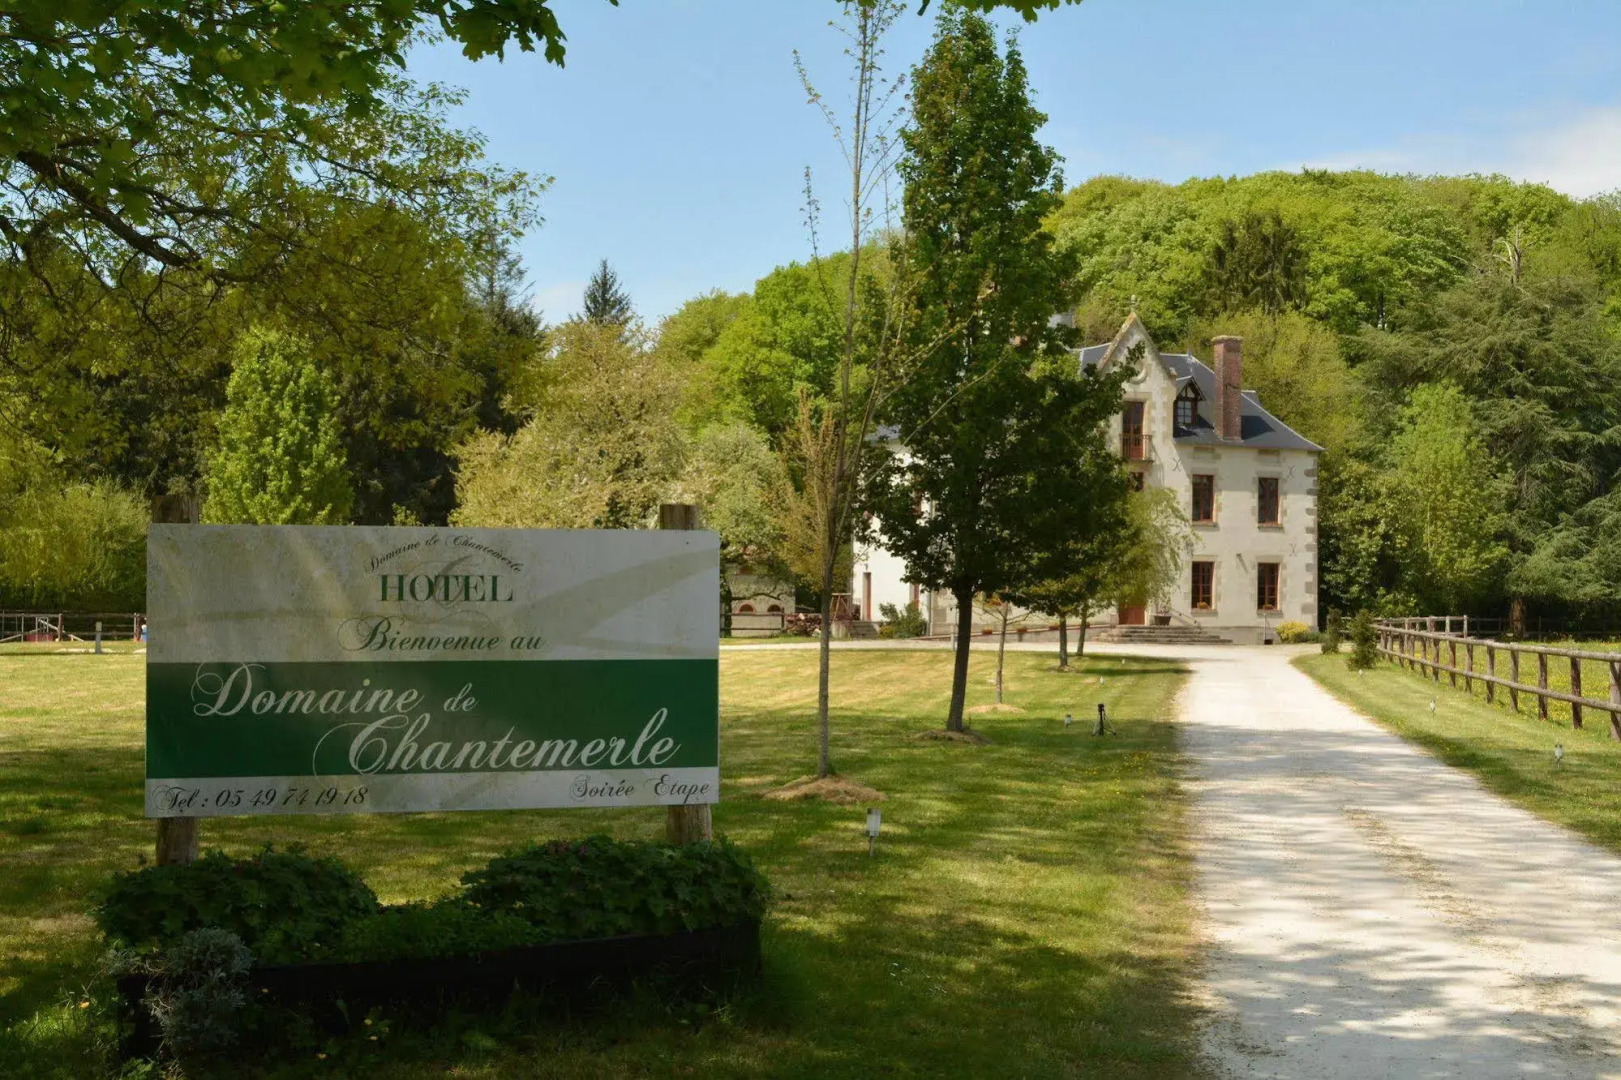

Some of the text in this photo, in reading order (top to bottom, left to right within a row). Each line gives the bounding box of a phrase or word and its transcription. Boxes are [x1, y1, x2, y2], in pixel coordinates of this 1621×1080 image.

[363, 534, 526, 574] Domaine de Chantemerle
[380, 574, 514, 602] HOTEL
[337, 614, 546, 651] Bienvenue au
[191, 659, 480, 717] Domaine de
[313, 707, 682, 779] Chantemerle
[215, 789, 245, 807] 05
[250, 788, 277, 807] 49
[315, 787, 338, 806] 19
[343, 786, 369, 805] 18
[569, 773, 713, 805] Soirée Etape
